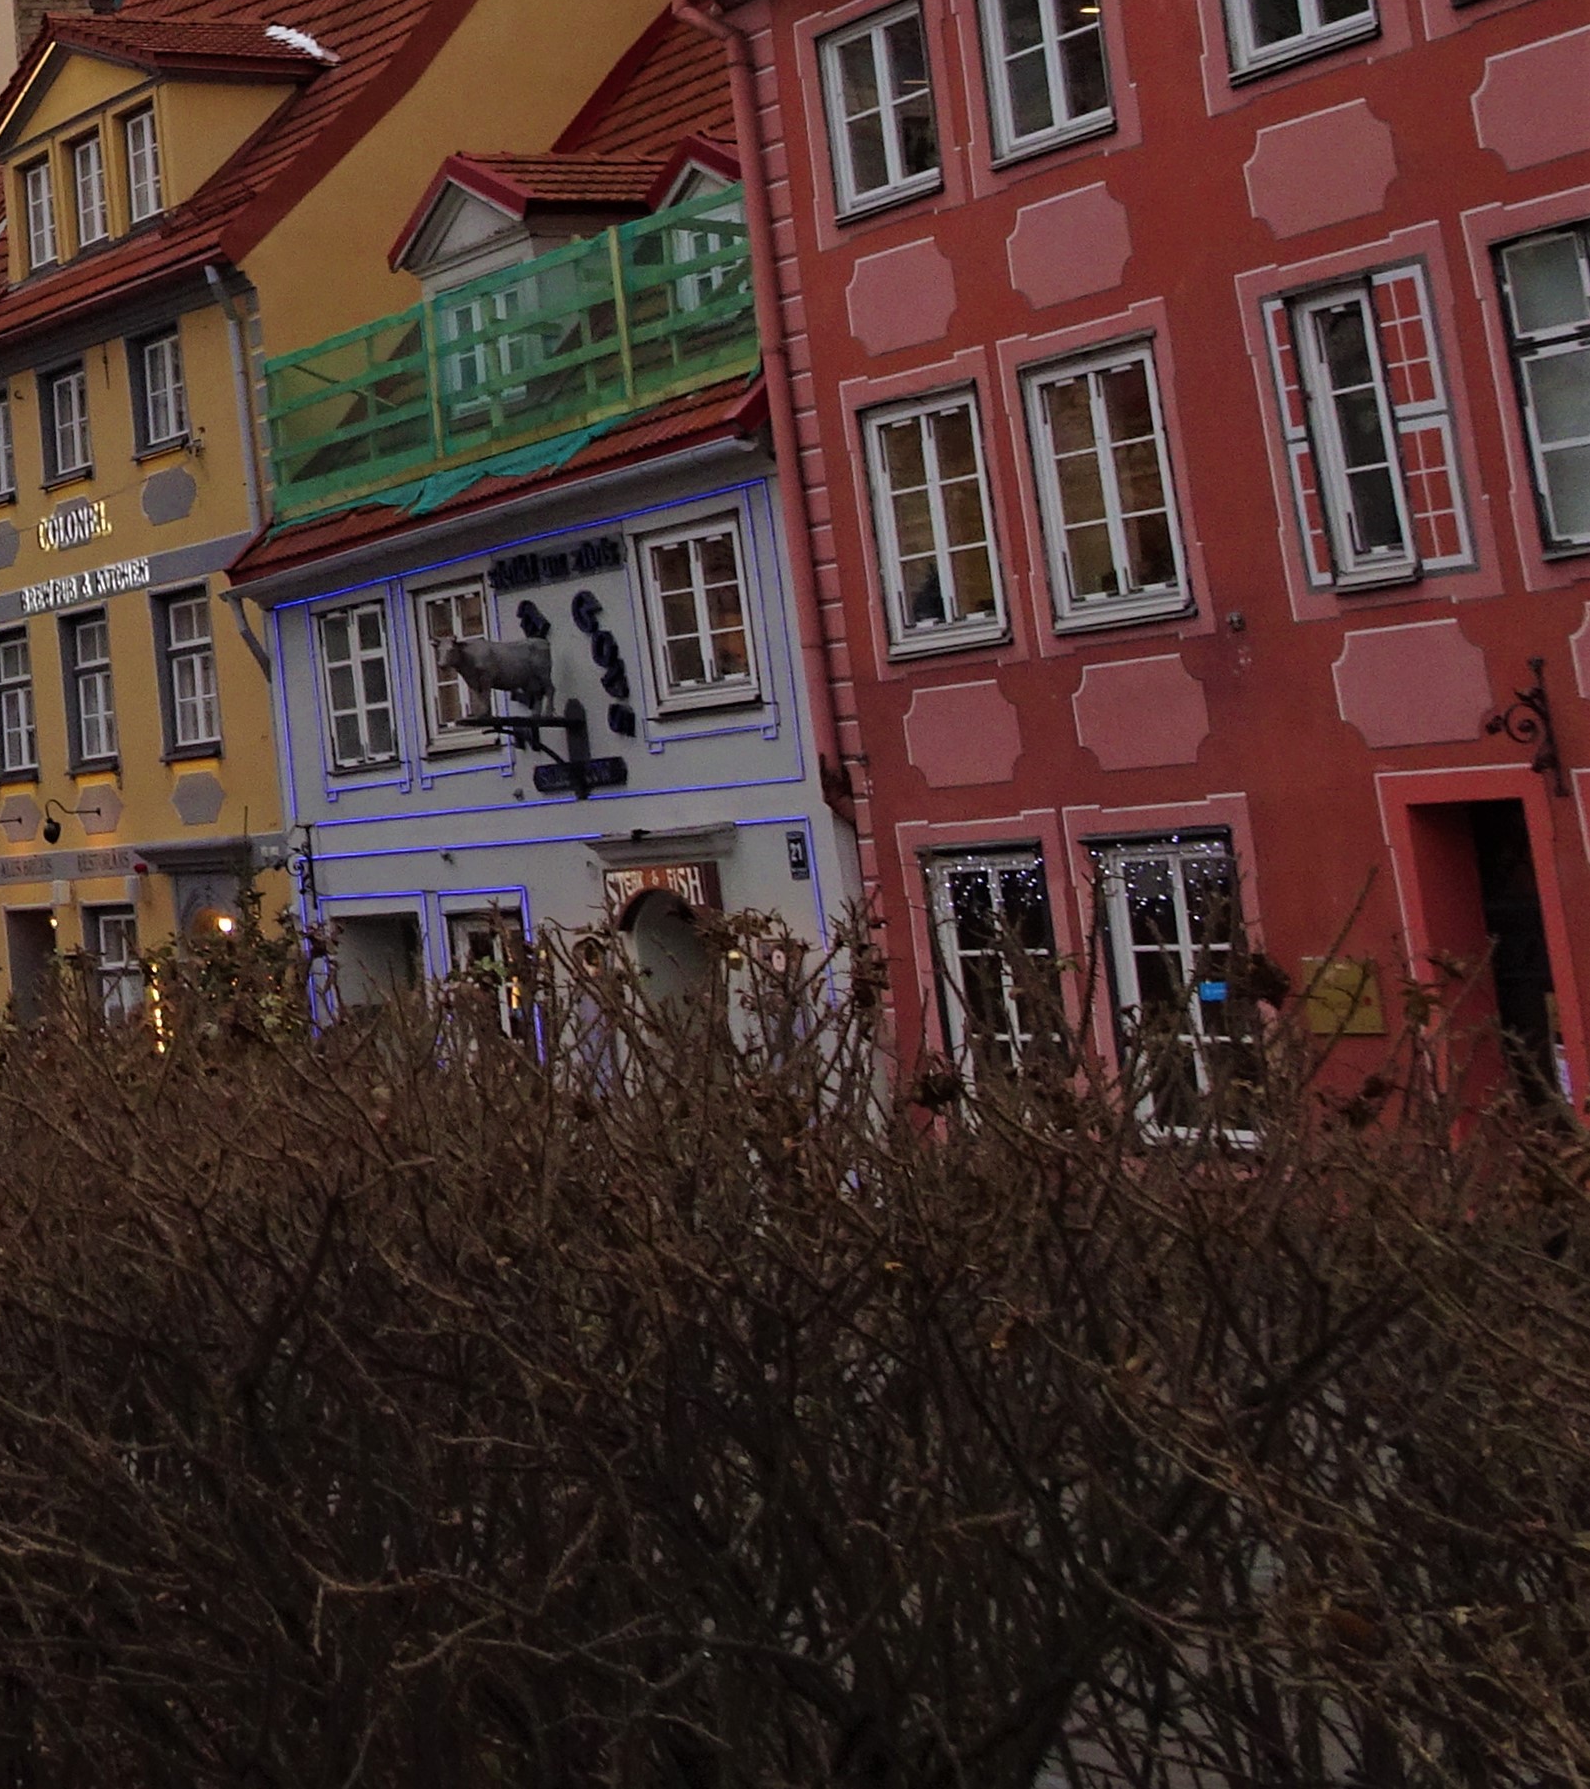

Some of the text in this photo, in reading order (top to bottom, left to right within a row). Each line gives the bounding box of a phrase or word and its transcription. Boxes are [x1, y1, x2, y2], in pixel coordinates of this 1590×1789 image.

[37, 501, 113, 552] COLONEL
[97, 558, 151, 595] KITCHEN
[789, 842, 803, 861] 21
[666, 866, 705, 906] FISH
